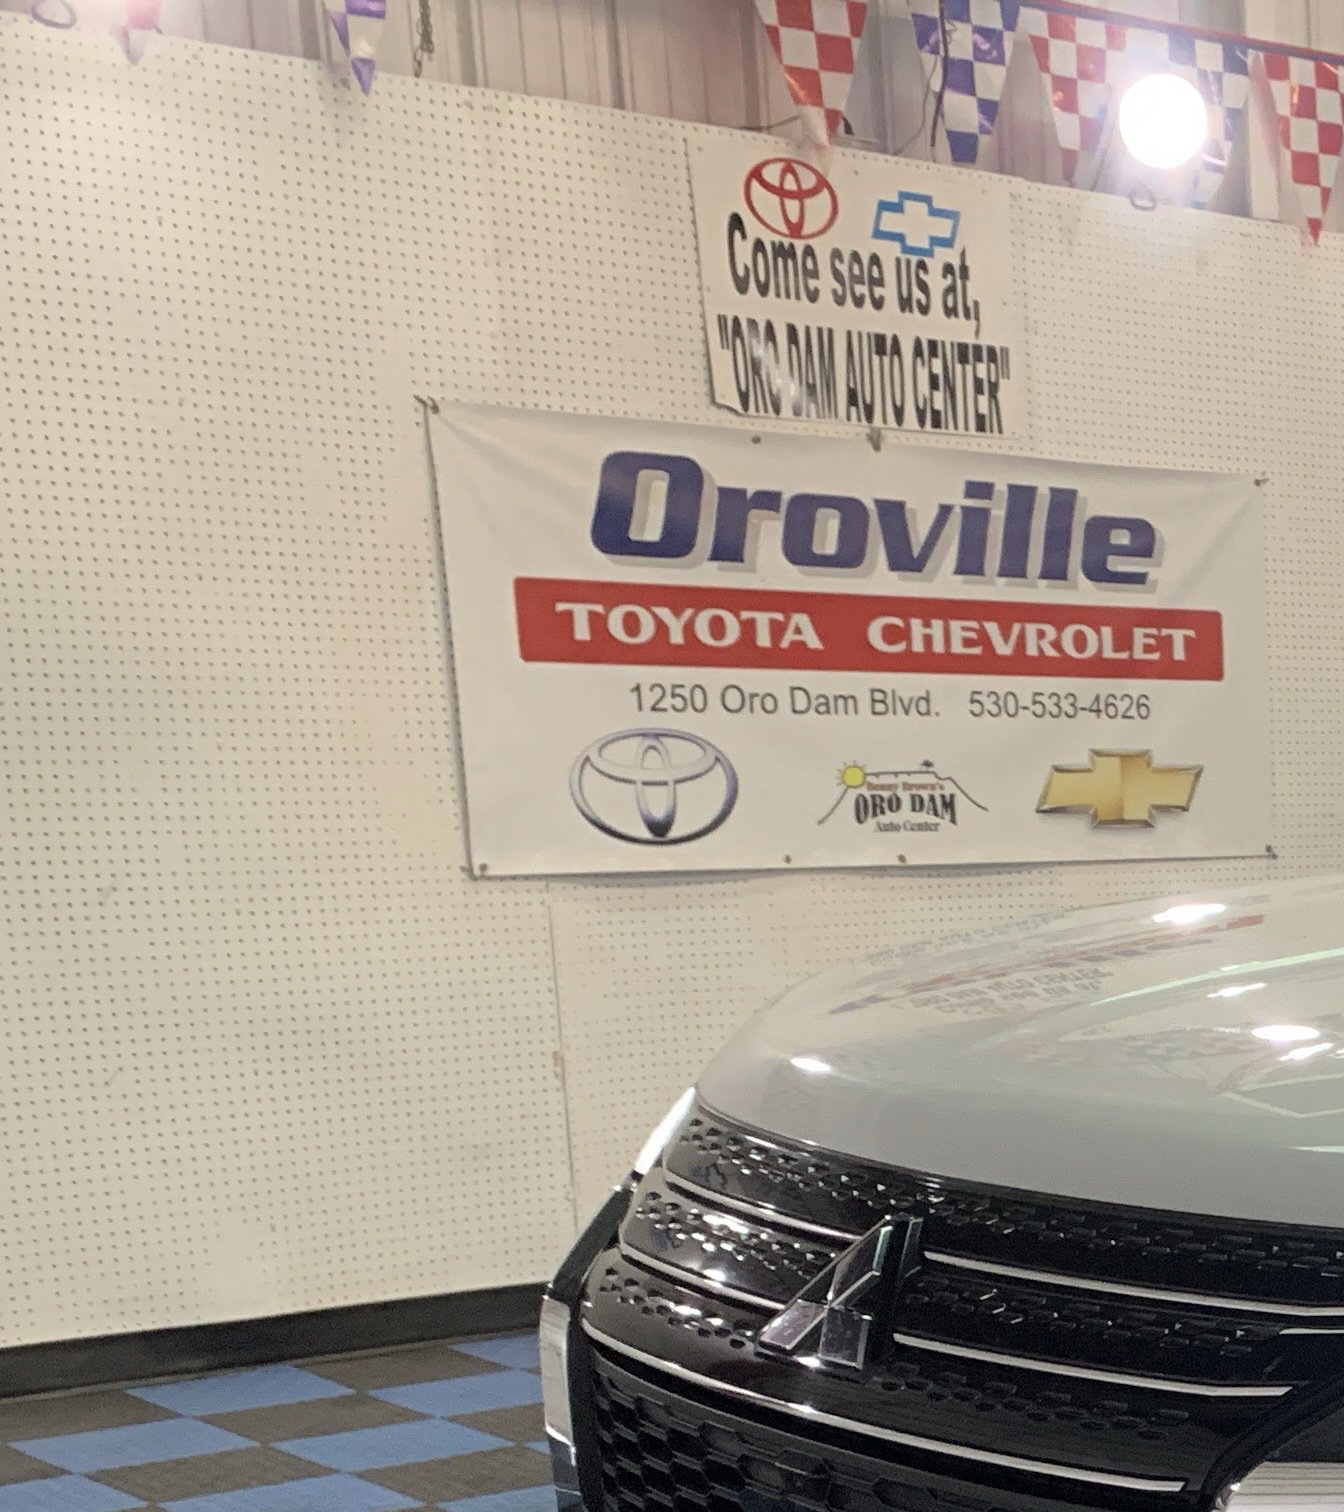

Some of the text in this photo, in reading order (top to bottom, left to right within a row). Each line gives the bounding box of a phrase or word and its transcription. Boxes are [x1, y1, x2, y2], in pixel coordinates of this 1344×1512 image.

[728, 212, 981, 340] Come see us at,
[786, 322, 838, 420] DAM
[846, 329, 905, 427] AUTO
[912, 335, 1011, 435] CENTER"
[590, 449, 1157, 585] Oroville
[555, 602, 1196, 661] TOYOTA CHEVROLET
[630, 682, 1152, 721] 1250 Oro Dam Blvd. 530-533-4626
[854, 793, 957, 826] ORO DAM
